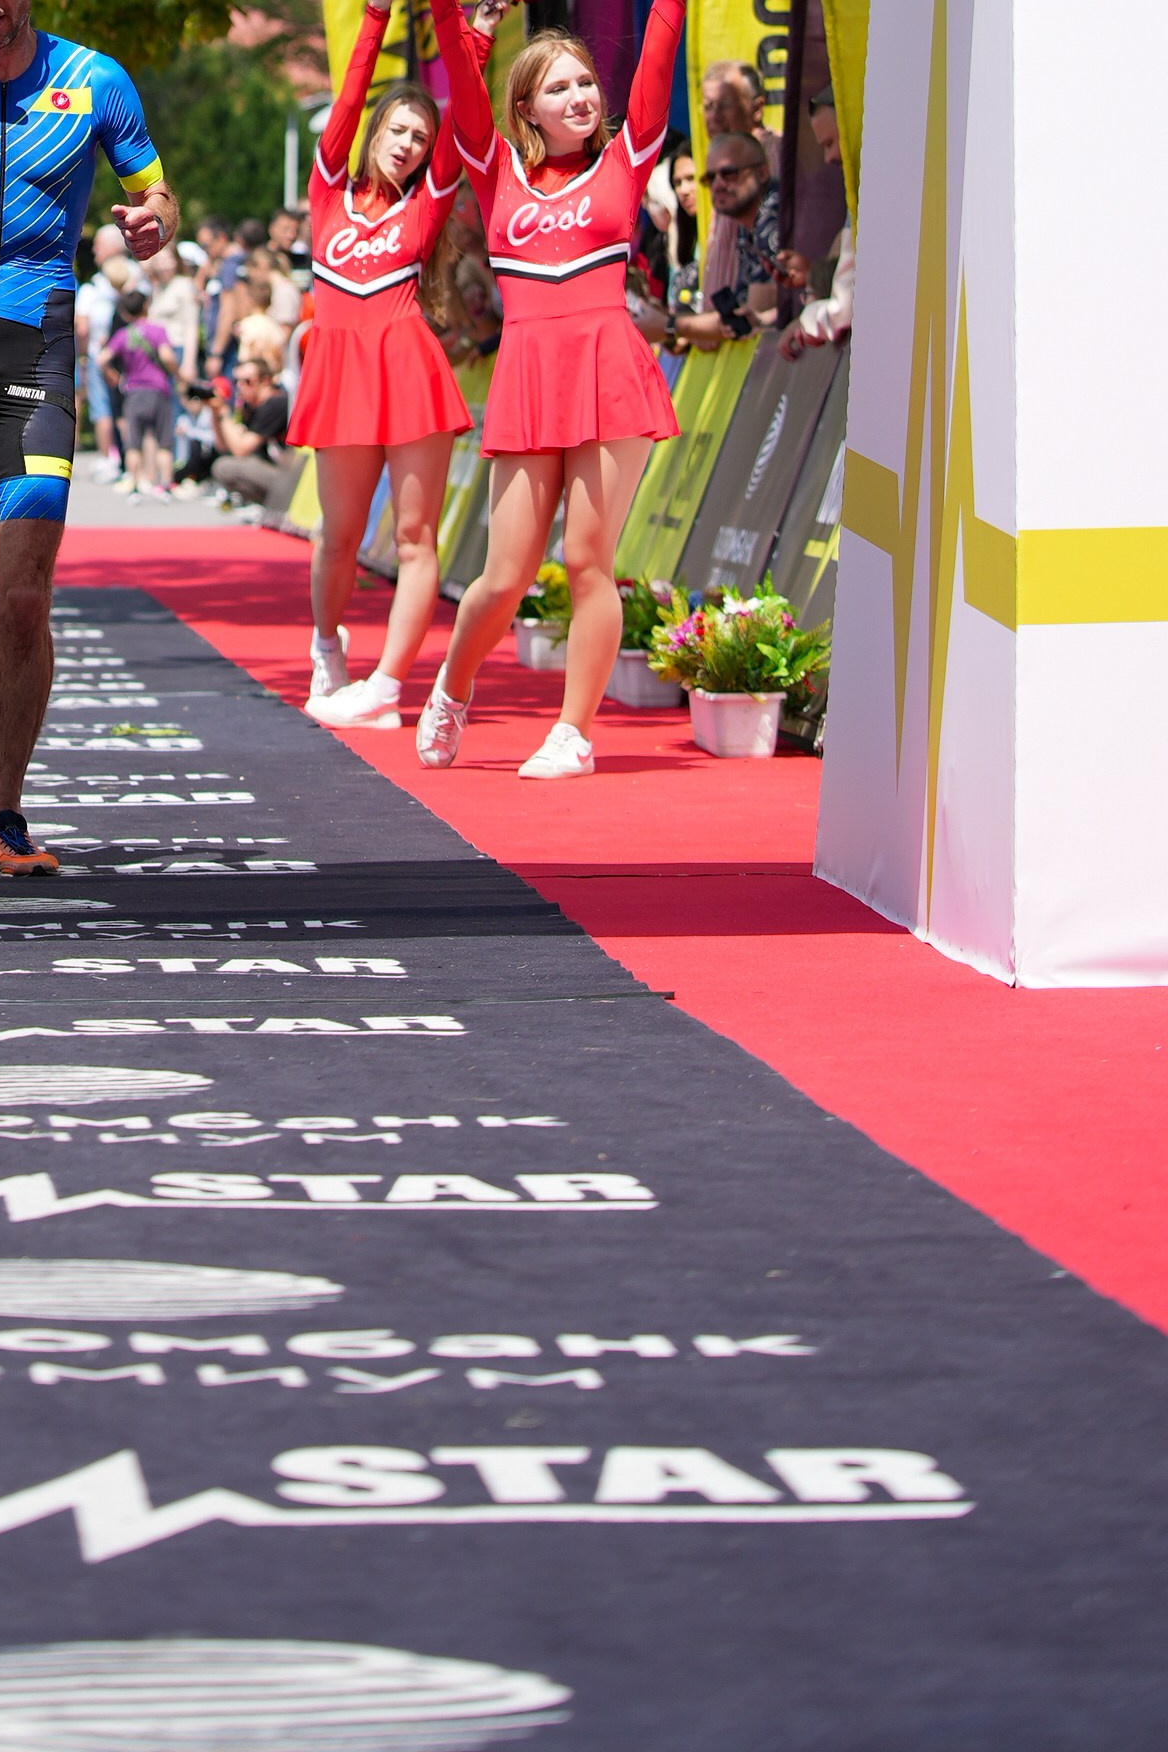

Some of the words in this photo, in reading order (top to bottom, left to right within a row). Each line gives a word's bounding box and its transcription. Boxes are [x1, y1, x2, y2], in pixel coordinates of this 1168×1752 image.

[506, 194, 593, 247] Cool
[325, 224, 401, 268] Cool
[7, 384, 46, 401] IRONSTAR
[51, 957, 407, 974] STAR
[72, 1016, 465, 1033] STAR
[149, 1172, 656, 1202] STAR
[268, 1445, 965, 1506] STAR
